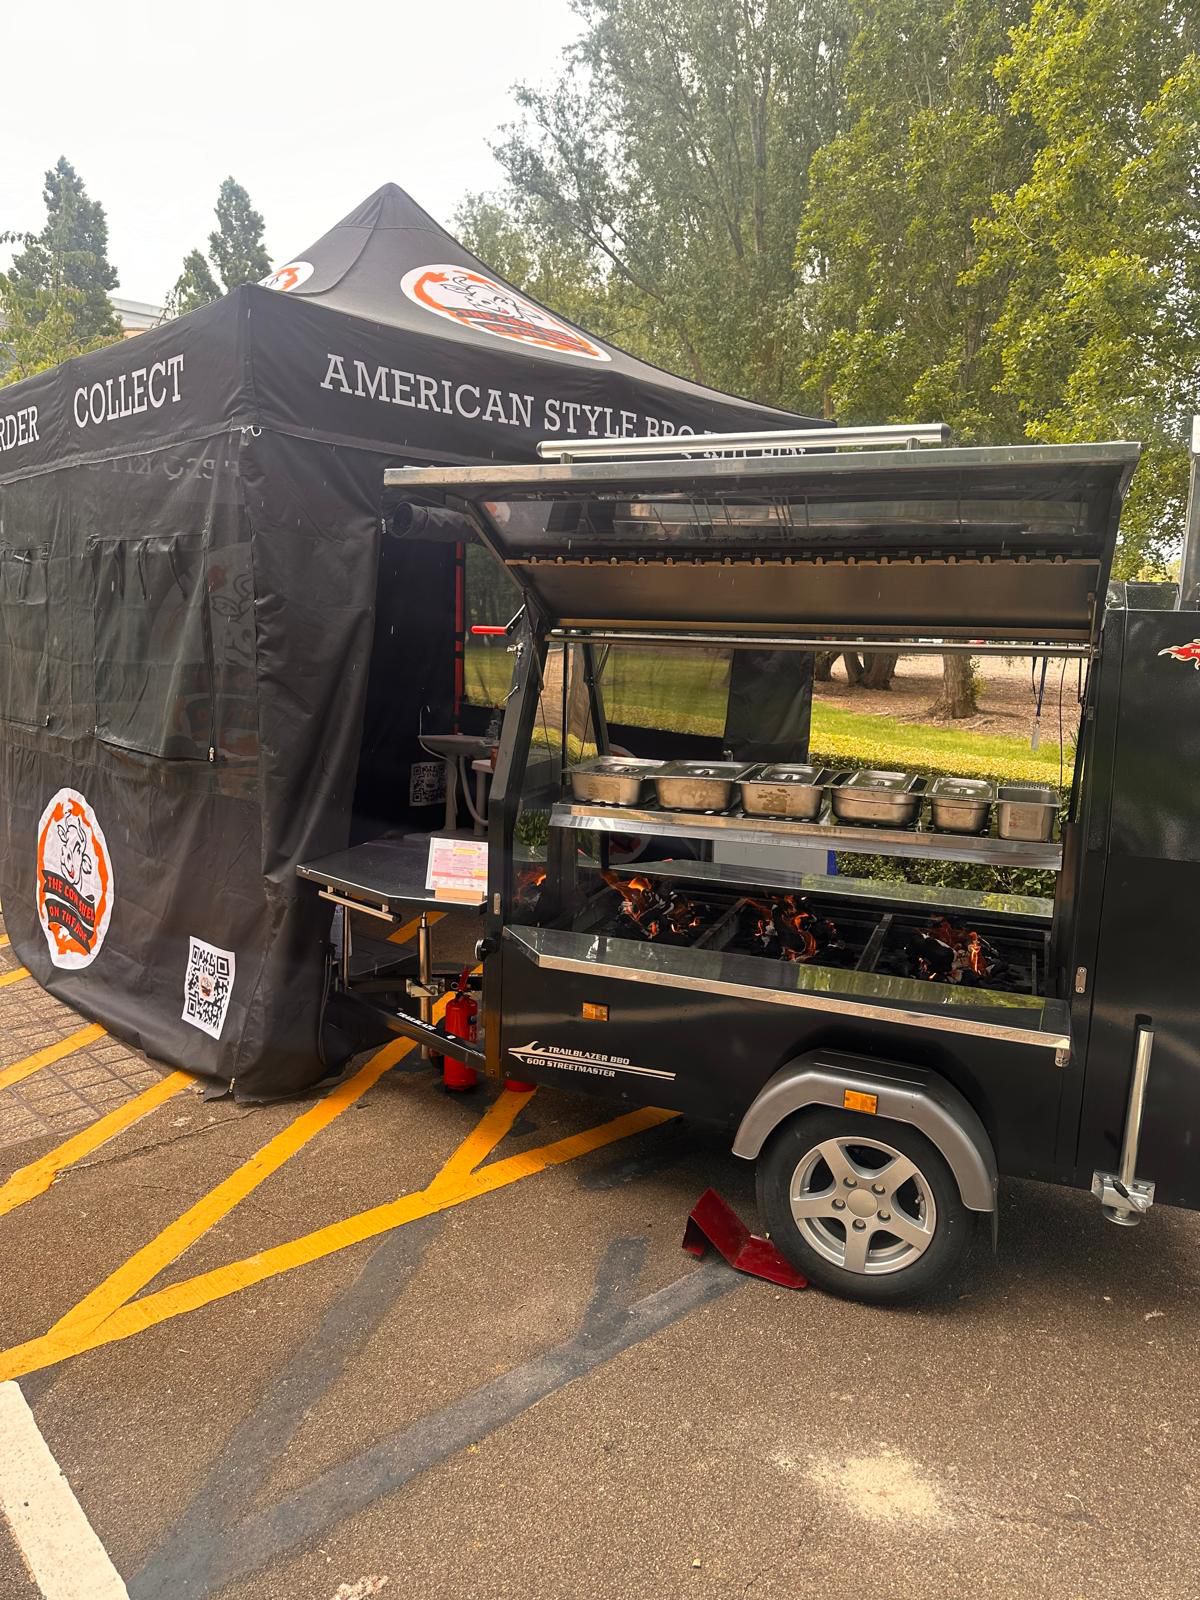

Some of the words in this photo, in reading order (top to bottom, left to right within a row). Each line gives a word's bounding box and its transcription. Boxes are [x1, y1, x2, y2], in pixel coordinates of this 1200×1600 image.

[74, 353, 184, 428] COLLECT
[320, 353, 534, 428] AMERICAN
[544, 399, 637, 439] STYLE
[48, 876, 63, 892] THE
[65, 885, 79, 905] COW
[49, 906, 60, 917] ON
[62, 910, 76, 926] THE
[548, 1046, 608, 1062] TRAILBLAZER
[526, 1057, 546, 1066] 600
[547, 1060, 616, 1078] STREETMASTER
